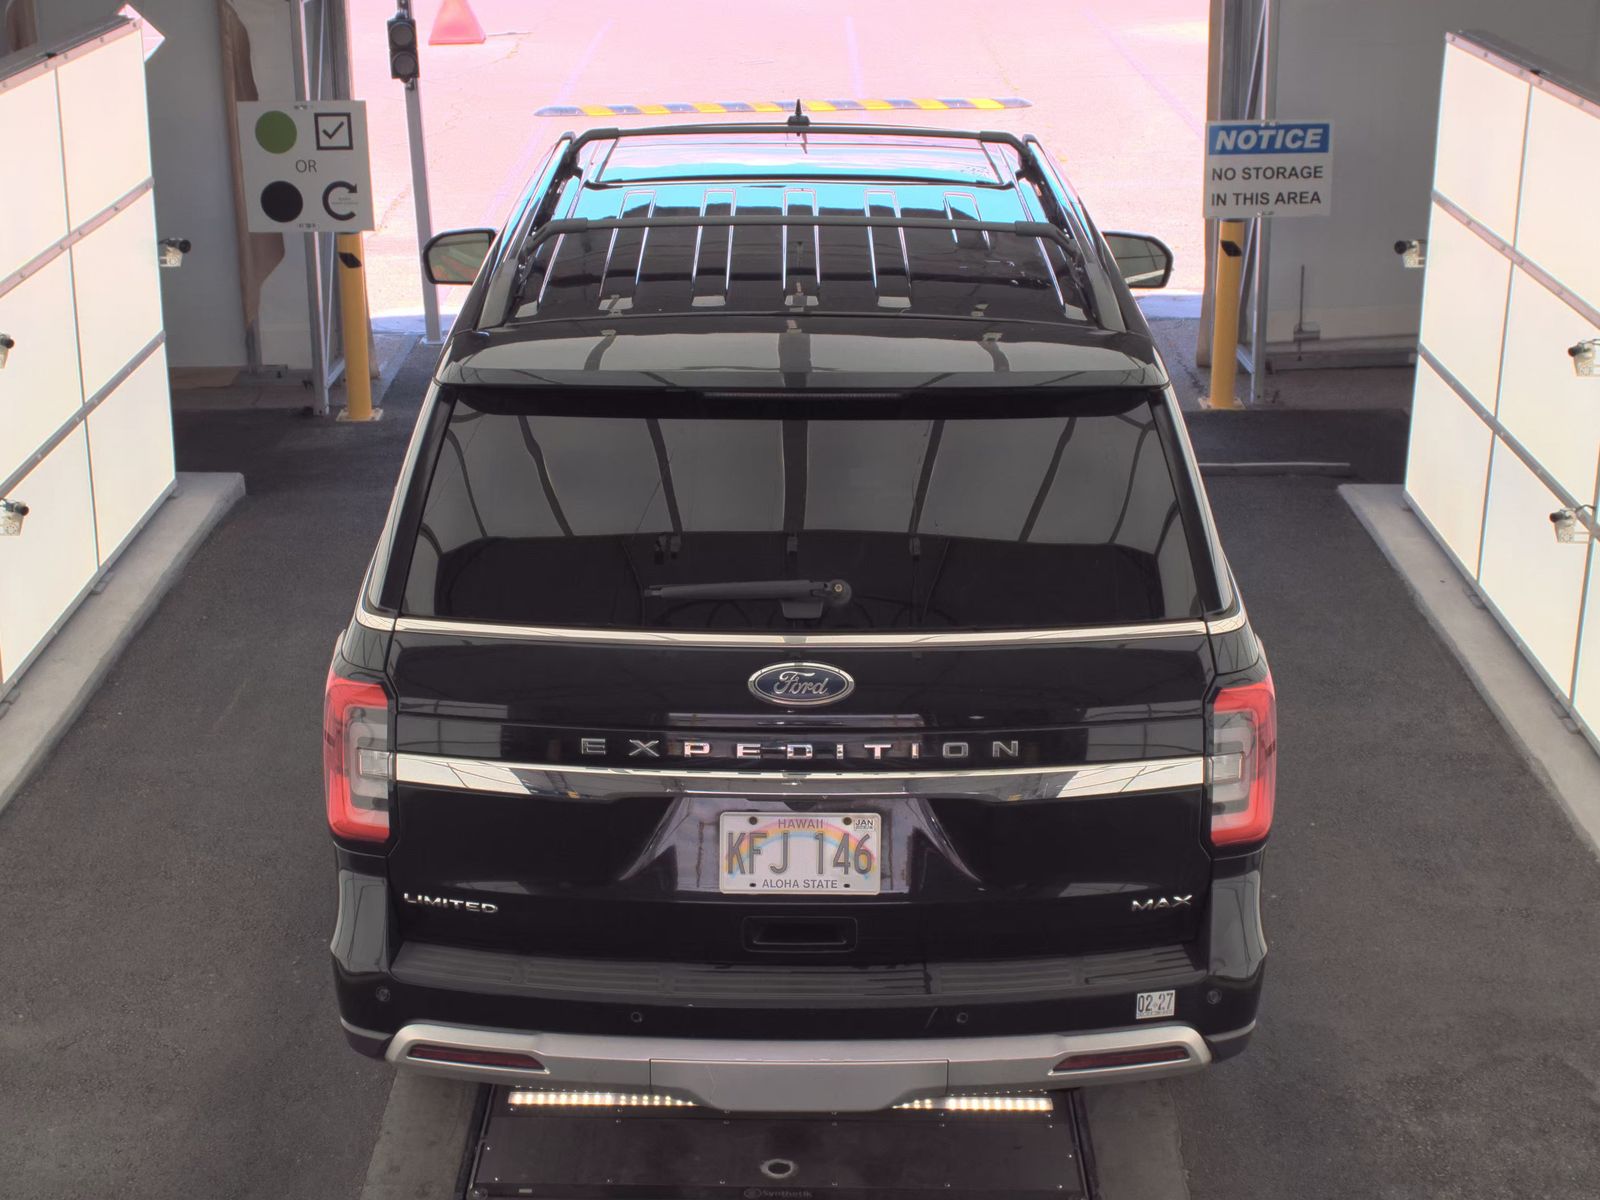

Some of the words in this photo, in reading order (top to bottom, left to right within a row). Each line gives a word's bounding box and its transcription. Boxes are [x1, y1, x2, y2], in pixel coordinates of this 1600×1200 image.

[1215, 128, 1323, 150] NOTICE
[295, 159, 317, 173] OR
[1212, 167, 1236, 181] NO
[1241, 165, 1323, 180] STORAGE
[1211, 193, 1227, 206] IN
[1233, 192, 1270, 205] THIS
[1274, 191, 1321, 205] AREA
[773, 670, 828, 695] Ford
[581, 737, 1019, 760] EXPEDITION
[777, 818, 824, 829] HAWAII
[727, 832, 791, 875] KFJ
[815, 832, 873, 875] 146
[762, 878, 800, 889] ALOHA
[803, 879, 838, 889] STATE
[403, 892, 499, 913] LIMITED
[1131, 894, 1193, 911] MAX
